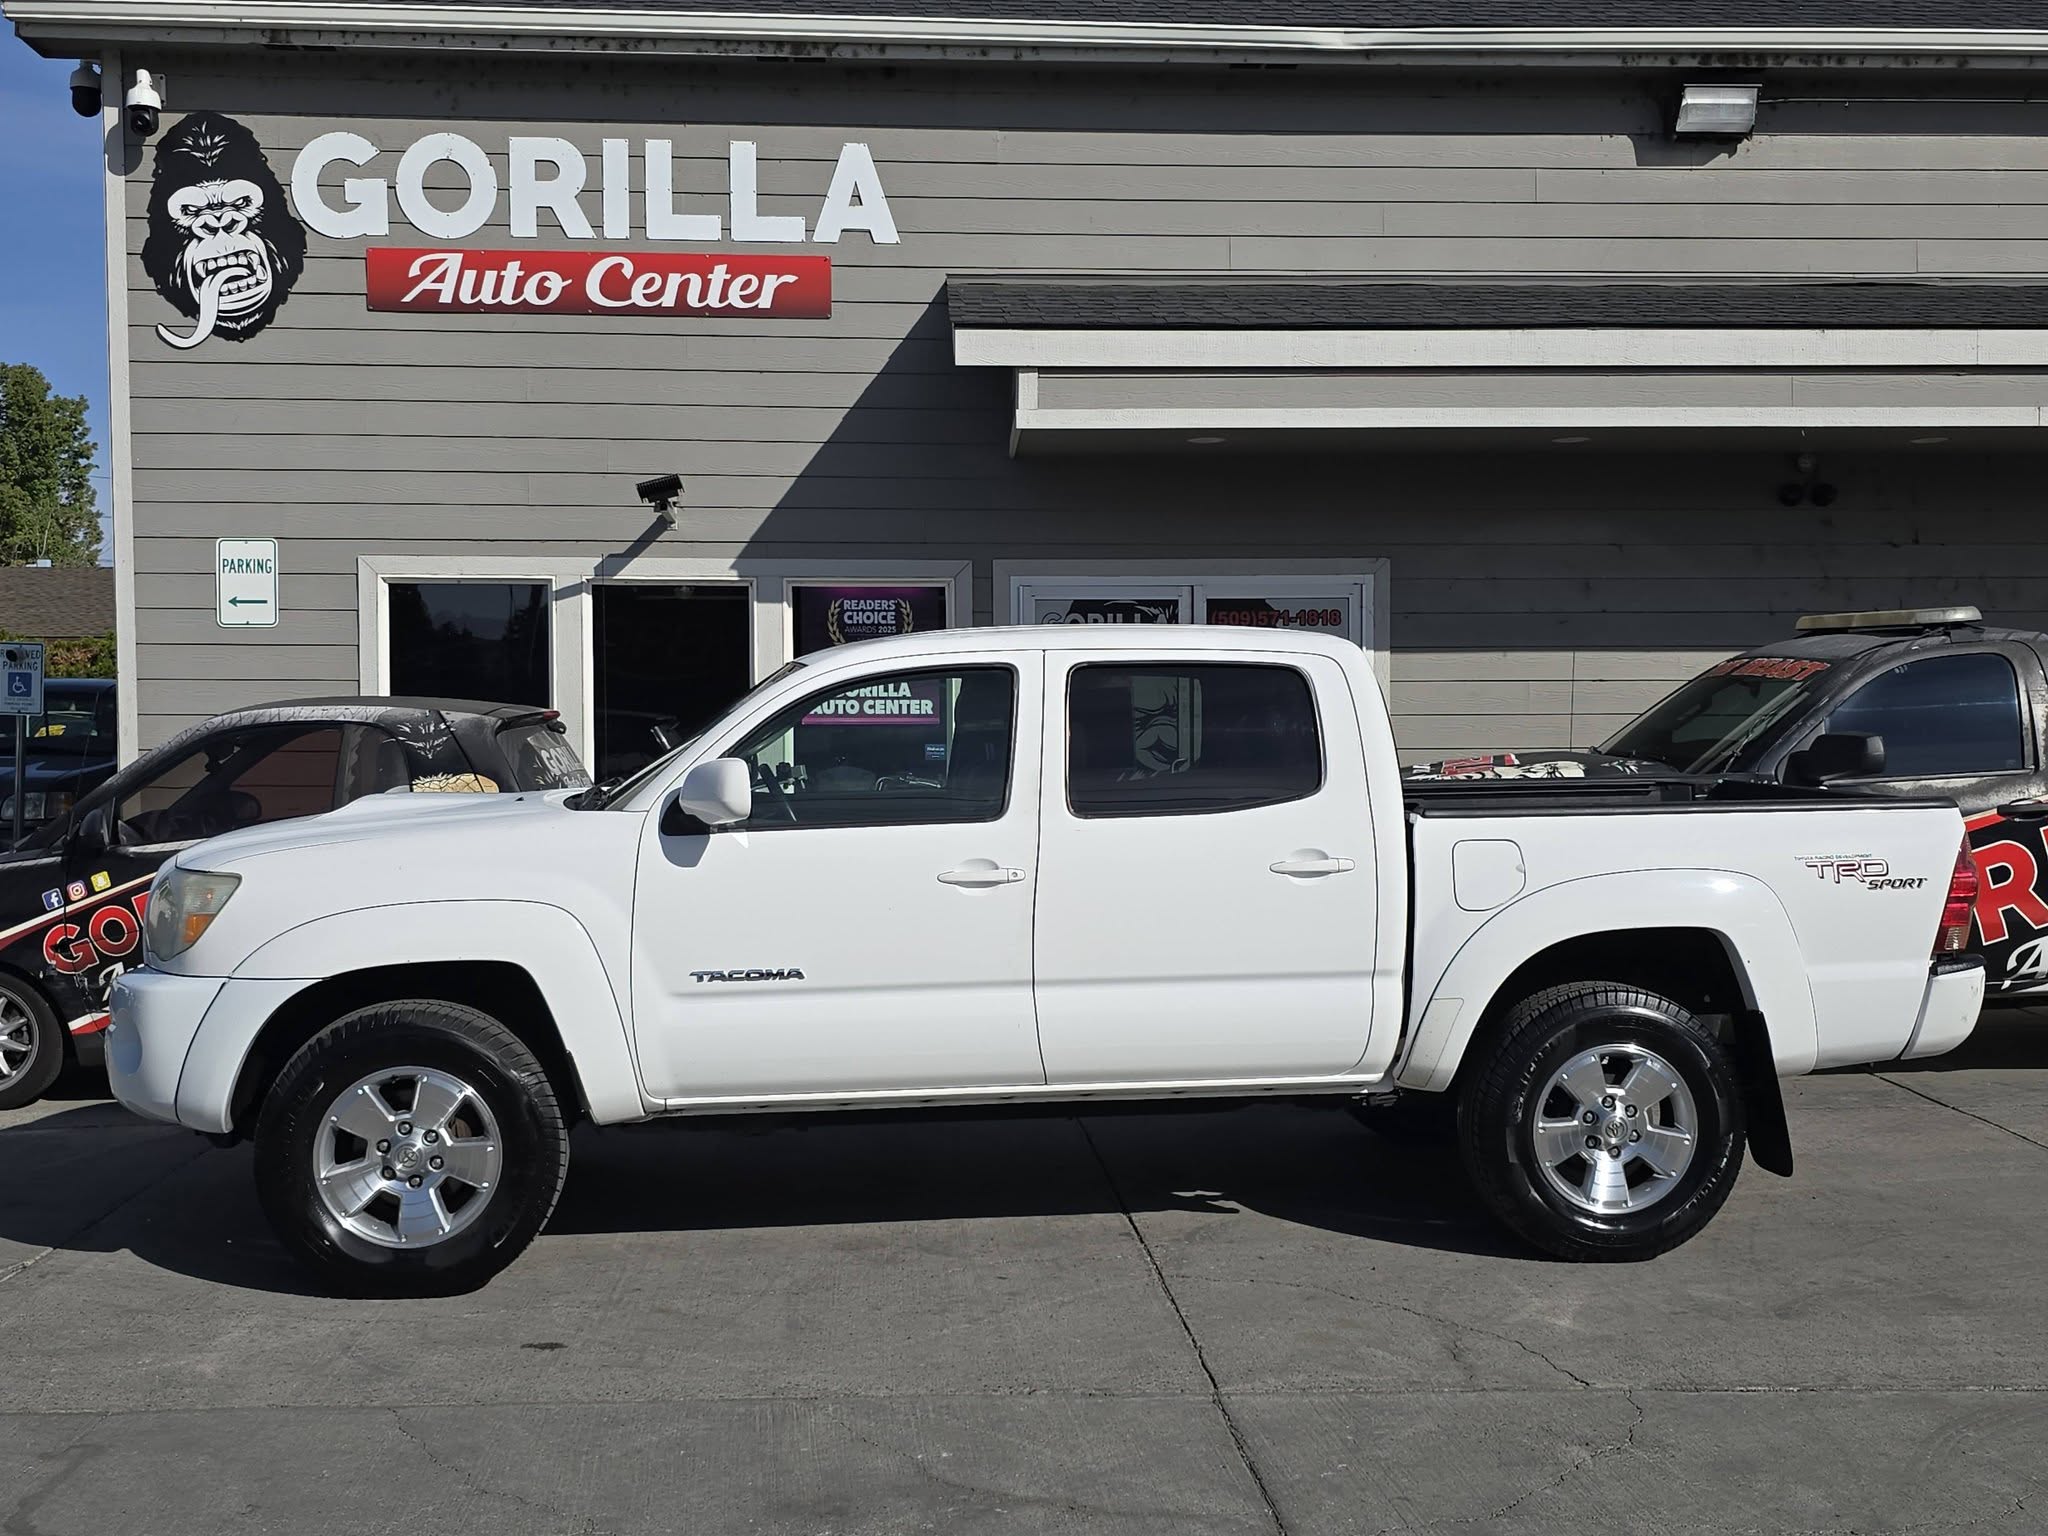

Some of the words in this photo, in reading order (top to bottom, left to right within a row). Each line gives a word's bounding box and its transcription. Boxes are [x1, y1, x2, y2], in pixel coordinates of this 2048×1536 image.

[291, 131, 901, 244] GORILLA
[401, 252, 572, 304] Auto
[585, 255, 799, 309] Center
[222, 558, 272, 574] PARKING
[843, 599, 898, 610] READERS'
[843, 611, 896, 624] CHOICE
[1211, 609, 1342, 626] (509)571-1818
[2, 661, 38, 671] PARKING
[836, 682, 912, 698] ORILLA
[863, 699, 934, 715] CENTER
[1805, 859, 1889, 884] TRD
[1867, 877, 1928, 890] SPORT
[689, 968, 805, 983] TACOMA
